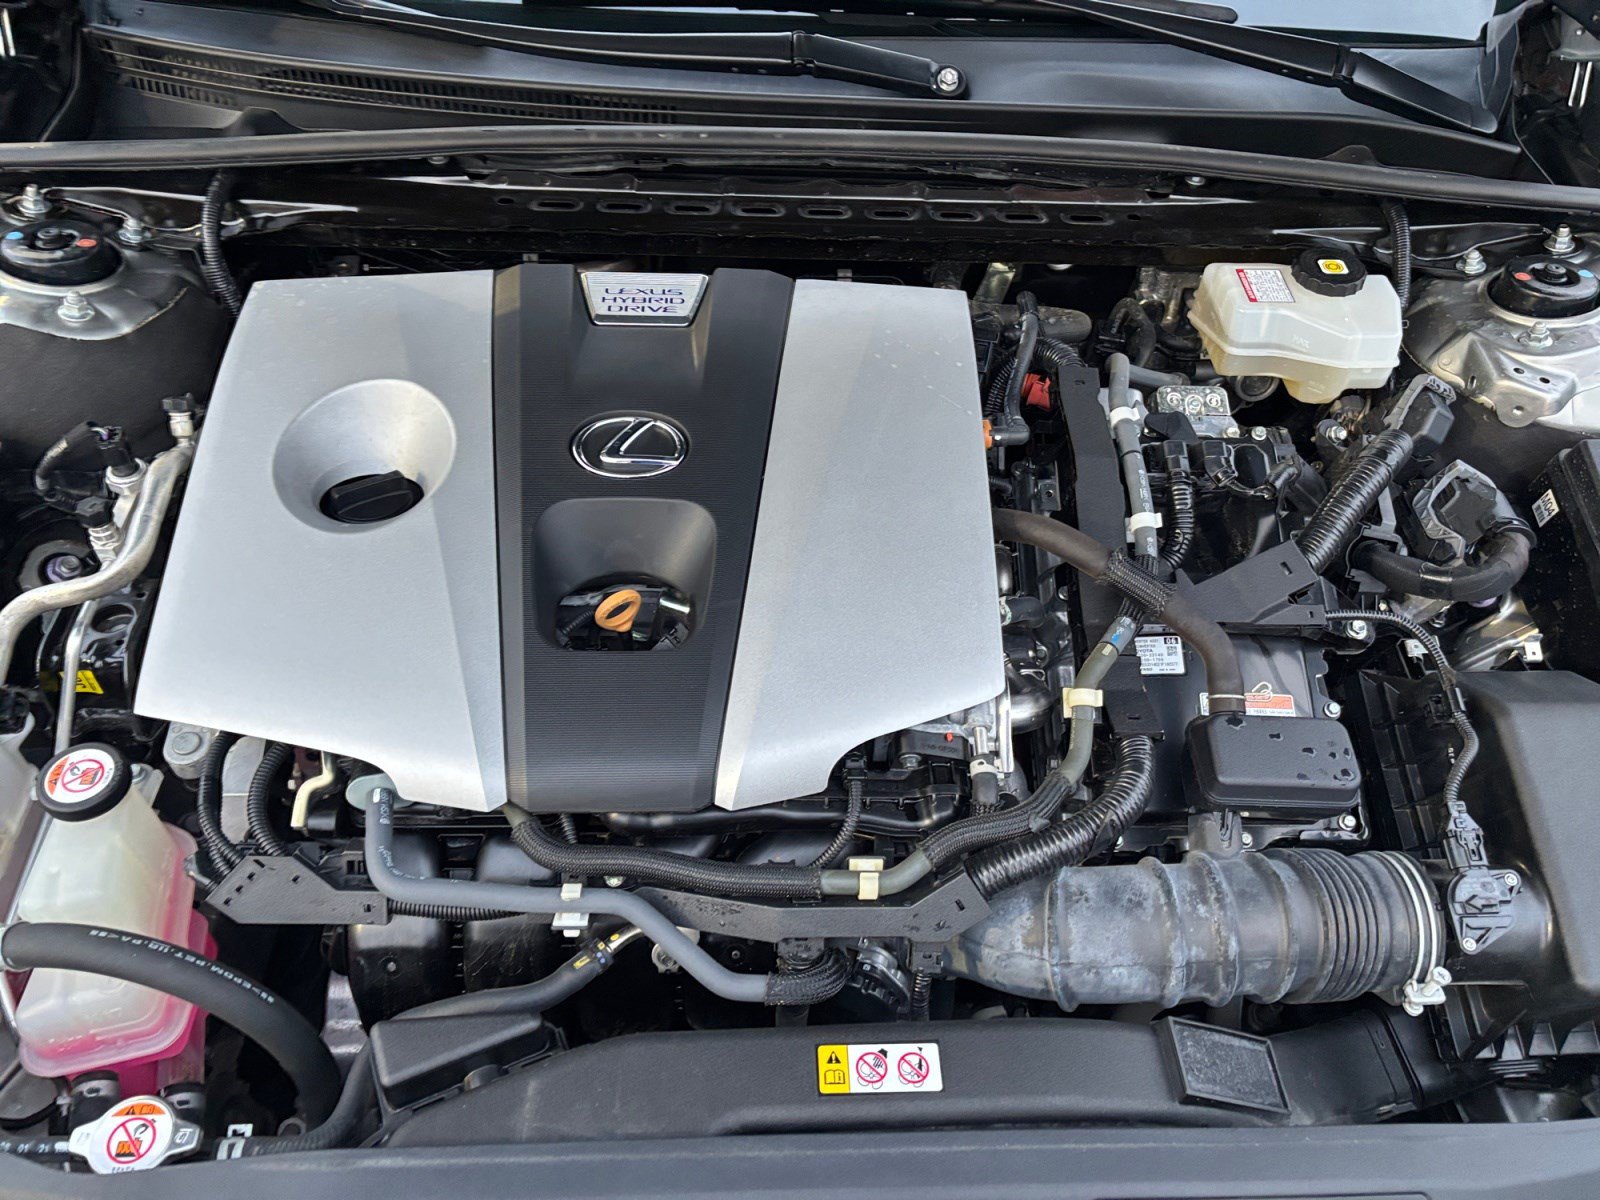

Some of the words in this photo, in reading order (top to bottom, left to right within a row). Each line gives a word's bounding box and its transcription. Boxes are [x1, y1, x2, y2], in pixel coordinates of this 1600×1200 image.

[604, 287, 683, 296] LEXUS
[602, 296, 685, 305] HYBRID
[607, 305, 678, 313] DRIVE
